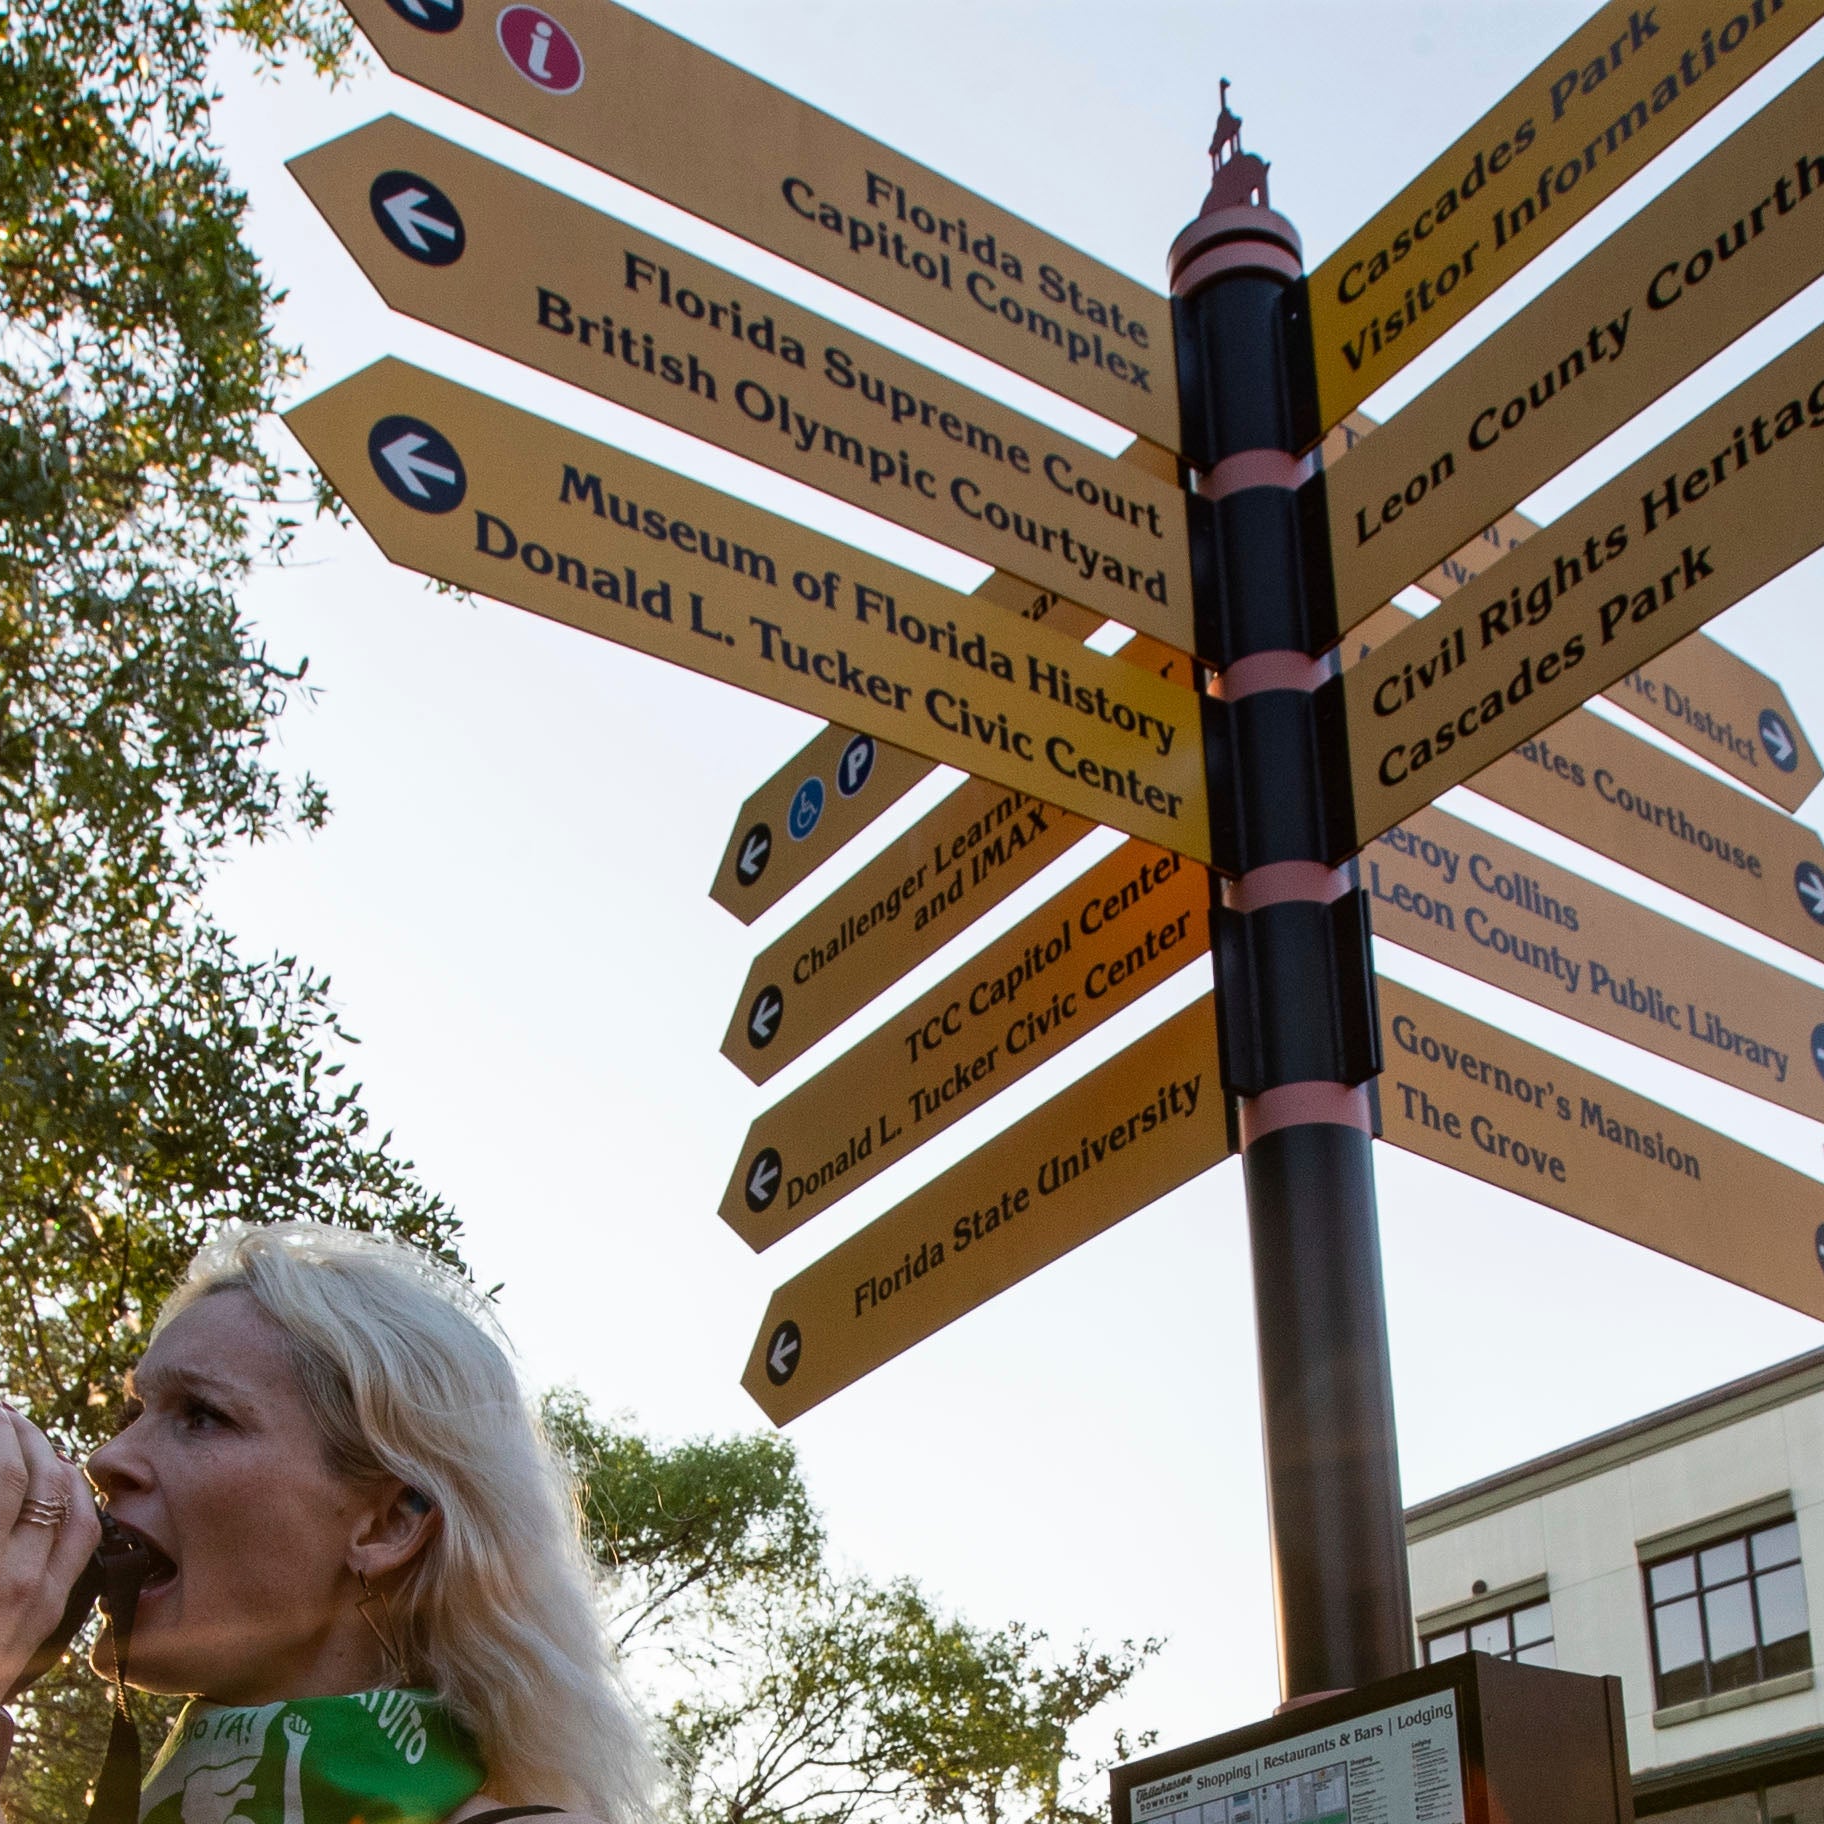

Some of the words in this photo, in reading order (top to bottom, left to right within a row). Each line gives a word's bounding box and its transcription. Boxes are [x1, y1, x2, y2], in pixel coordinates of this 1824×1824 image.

[864, 170, 1024, 281] Florida
[1038, 267, 1150, 349] State
[1336, 116, 1538, 308] Cascades
[1546, 5, 1663, 124] Park
[781, 178, 953, 290] Capitol
[968, 271, 1153, 394] Complex
[1342, 234, 1482, 378] Visitor
[536, 285, 718, 400] British
[735, 379, 936, 500] Olympic
[950, 481, 1168, 606] Courtyard
[624, 252, 807, 368] Florida
[823, 345, 1031, 473] Supreme
[1045, 454, 1164, 538] Court
[1354, 446, 1456, 547] Leon
[1468, 306, 1633, 455] County
[474, 510, 673, 624] Donald
[690, 596, 736, 648] L.
[749, 617, 913, 715] Tucker
[924, 688, 1035, 763] Civic
[1045, 735, 1183, 820] Center
[558, 464, 777, 584] Museum
[792, 567, 846, 612] of
[854, 591, 1015, 683] Florida
[1026, 657, 1177, 757] History
[1373, 628, 1468, 720] Civil
[1478, 499, 1630, 652] Rights
[1377, 632, 1587, 790] Cascades
[1597, 535, 1717, 646] Park
[1512, 739, 1586, 787] ates
[1594, 767, 1763, 877] Courthouse
[1662, 682, 1759, 767] District
[792, 866, 928, 985] Challenger
[935, 790, 1030, 875] Learni
[905, 1006, 963, 1063] TCC
[969, 920, 1072, 1017] Capitol
[1079, 853, 1186, 936] Center
[914, 875, 965, 933] and
[972, 803, 1049, 886] IMAX
[1369, 861, 1456, 932] Leon
[1464, 906, 1581, 995] County
[1589, 959, 1683, 1032] Public
[1687, 1004, 1790, 1083] Library
[1378, 826, 1460, 884] eroy
[1469, 853, 1580, 932] Collins
[786, 1128, 872, 1210] Donald
[879, 1116, 903, 1147] L.
[908, 1047, 998, 1124] Tucker
[1006, 992, 1077, 1055] Civic
[1084, 909, 1191, 1000] Center
[1392, 1014, 1572, 1121] Governor's
[1579, 1097, 1703, 1181] Mansion
[1397, 1081, 1463, 1140] The
[1469, 1114, 1568, 1183] Grove
[854, 1242, 946, 1318] Florida
[953, 1187, 1031, 1253] State
[1037, 1073, 1202, 1196] University
[1140, 1790, 1189, 1812] DOWNTOWN
[1196, 1763, 1252, 1792] Shopping
[1263, 1737, 1336, 1770] Restaurants
[1339, 1731, 1351, 1747] &
[1354, 1724, 1383, 1744] Bars
[1397, 1702, 1454, 1730] Lodging
